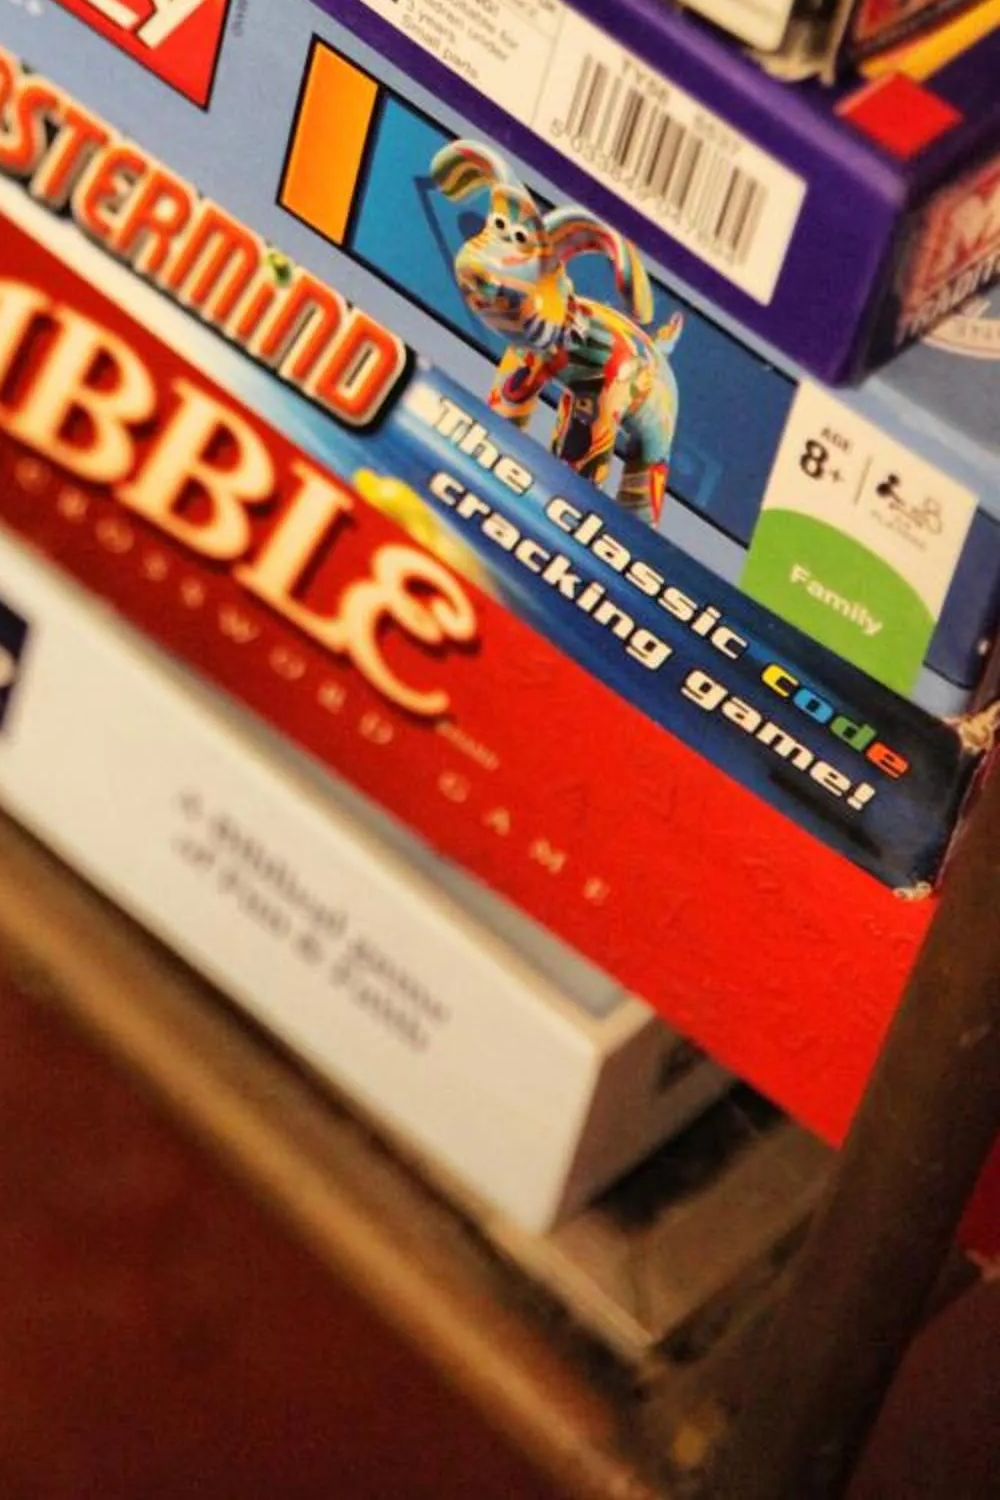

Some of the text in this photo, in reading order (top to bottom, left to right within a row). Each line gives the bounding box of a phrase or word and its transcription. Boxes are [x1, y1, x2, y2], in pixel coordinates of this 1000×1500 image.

[399, 11, 441, 51] Small
[466, 23, 510, 65] under
[799, 438, 846, 481] 8+
[432, 394, 910, 780] The classic code
[789, 563, 883, 637] Family
[428, 470, 877, 812] cracking game!
[437, 770, 610, 903] GAME
